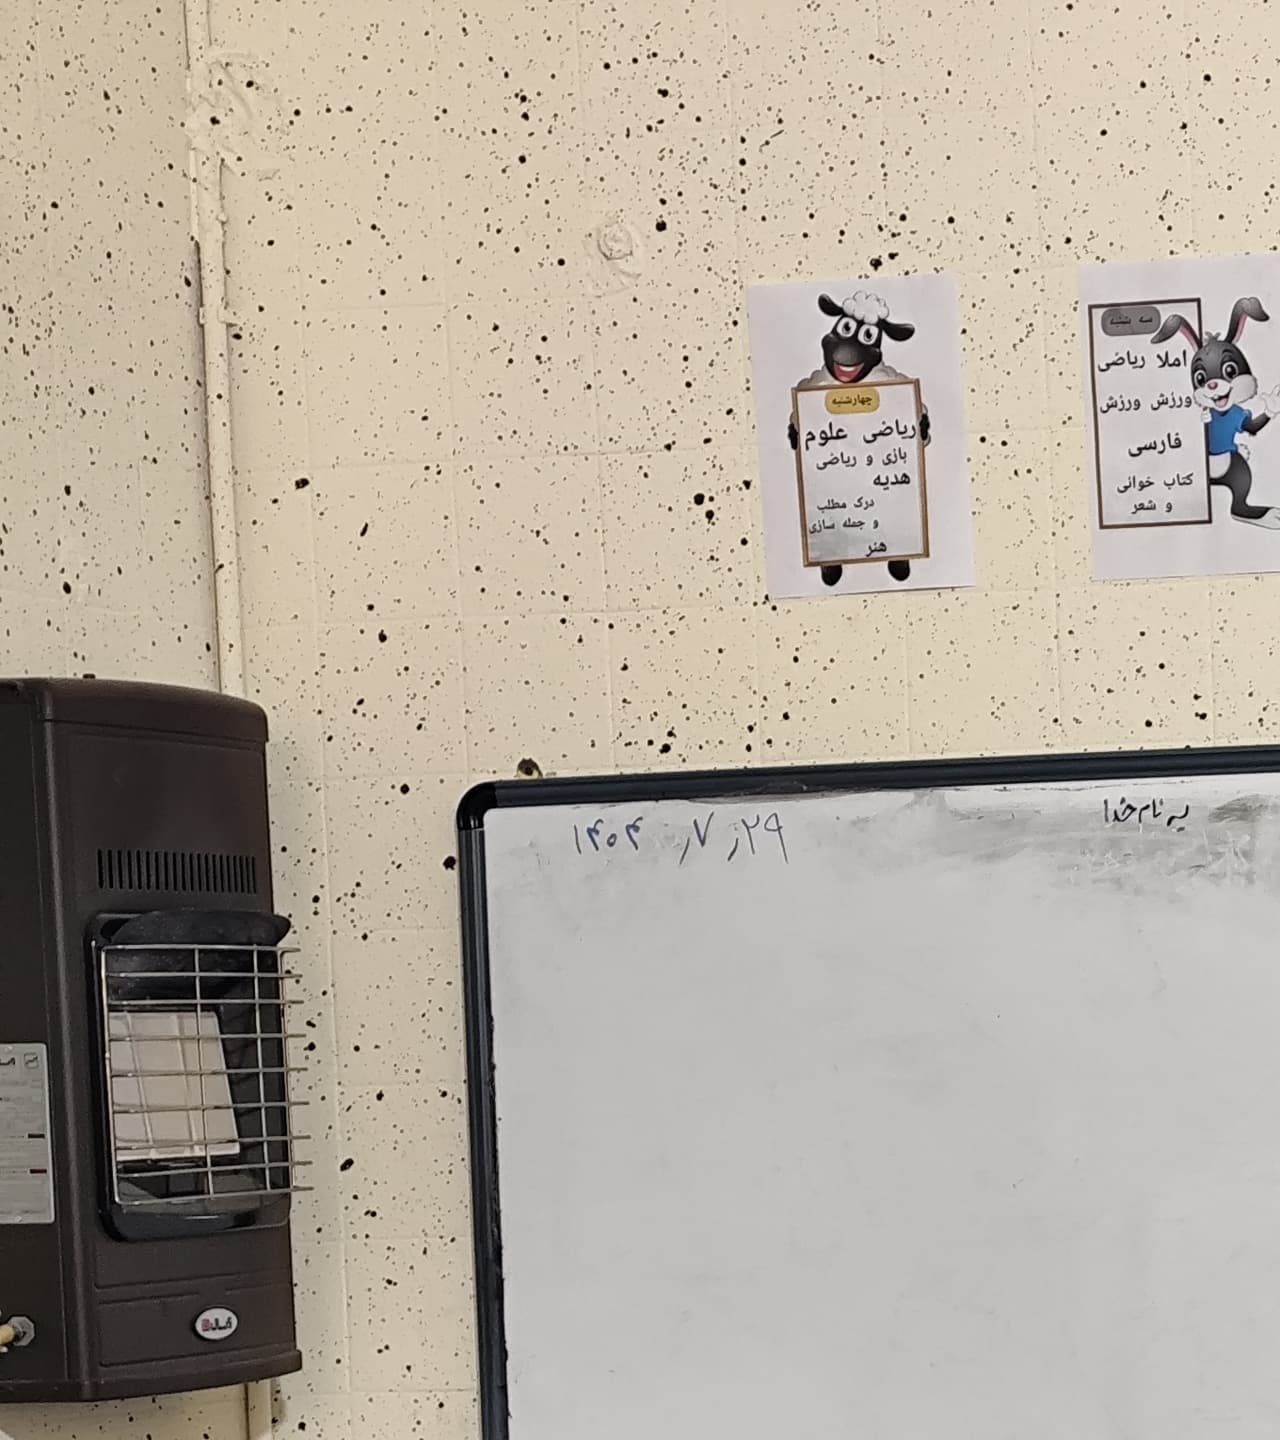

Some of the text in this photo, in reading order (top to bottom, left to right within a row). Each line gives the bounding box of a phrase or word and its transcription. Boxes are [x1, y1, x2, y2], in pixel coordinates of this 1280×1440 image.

[1098, 349, 1187, 372] املا ریاضی
[831, 394, 872, 405] چهارشنبه
[1100, 392, 1192, 413] ورزش ورزش
[804, 421, 916, 449] ریاضی علوم
[1128, 433, 1182, 457] فارسی
[816, 448, 907, 471] بازی و ریاضی
[873, 472, 910, 490] هدیه
[1116, 473, 1194, 492] کتاب خوانی
[817, 497, 875, 511] درک مطلب
[1132, 500, 1172, 514] و شعر
[809, 518, 878, 534] و جمله سازی
[865, 542, 887, 557] هنر
